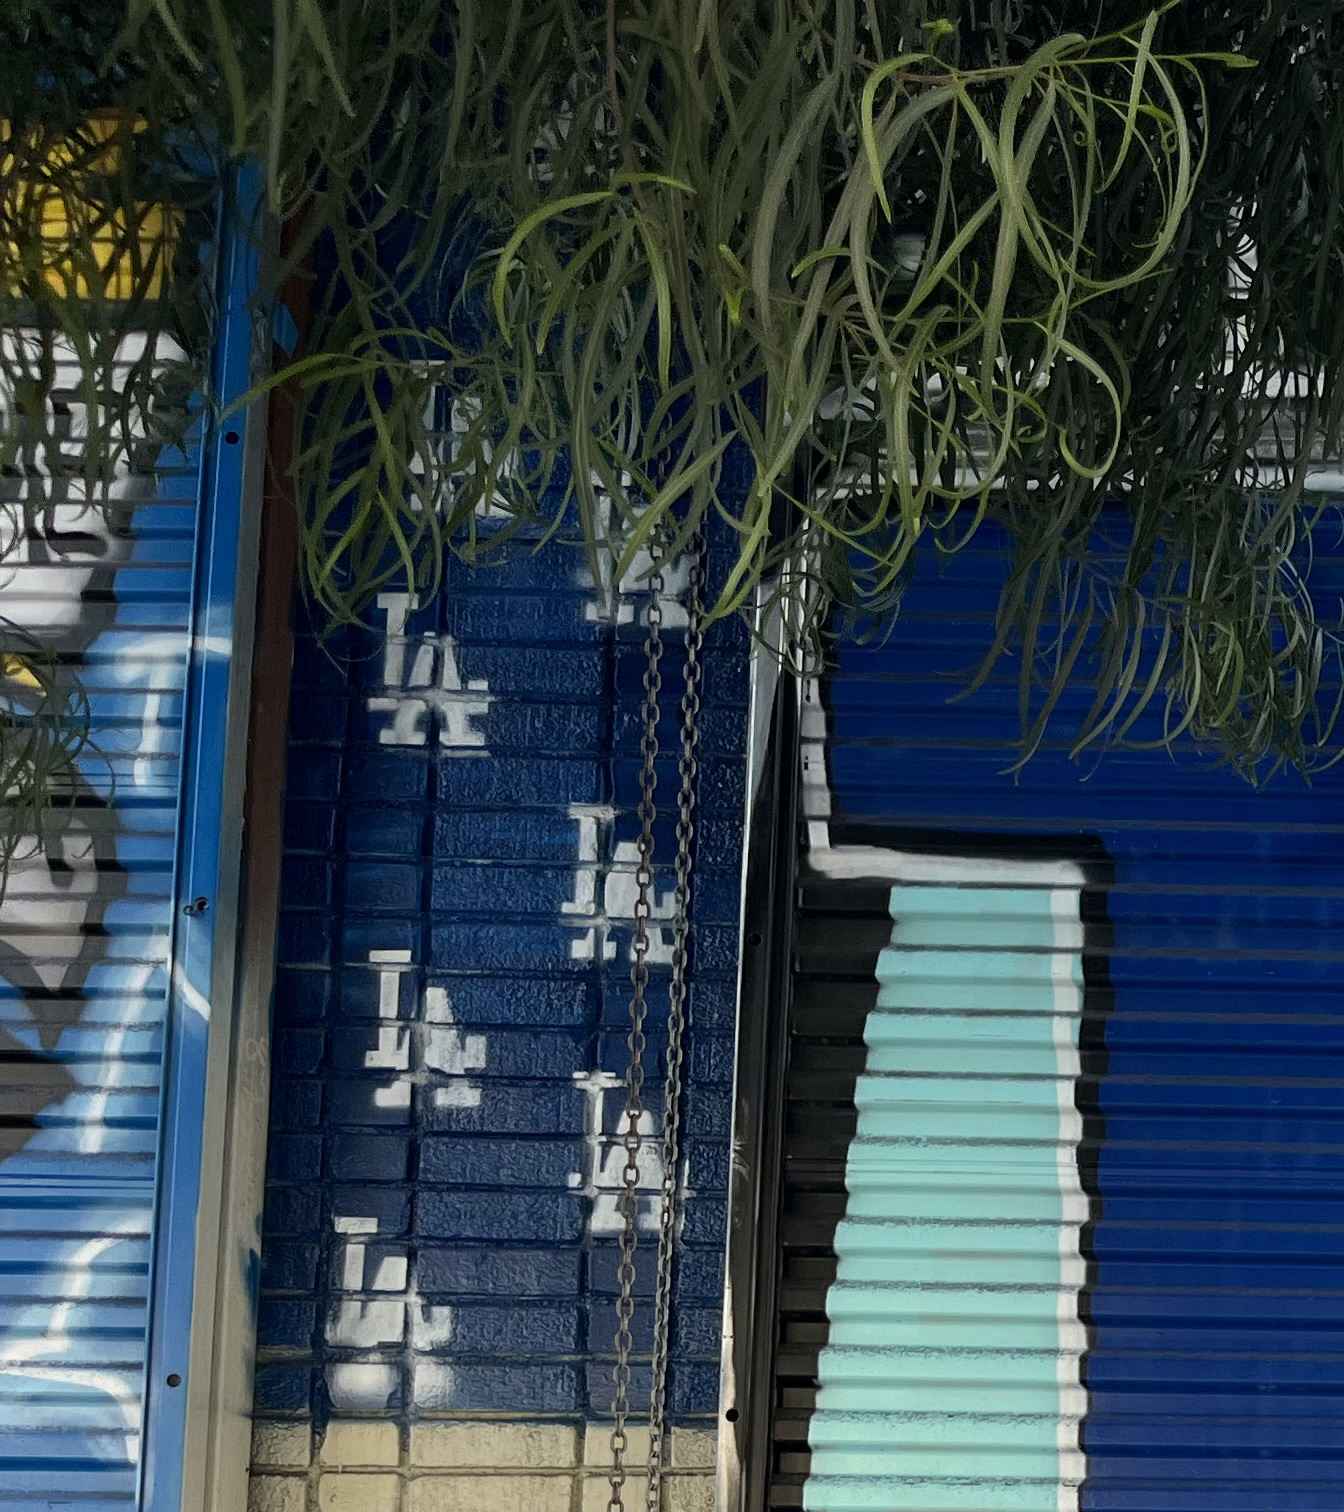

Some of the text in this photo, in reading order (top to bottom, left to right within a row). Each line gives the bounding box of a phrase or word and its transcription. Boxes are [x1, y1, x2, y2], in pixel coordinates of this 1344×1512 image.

[366, 592, 495, 757] LA
[559, 802, 688, 965] LA
[364, 950, 487, 1108] LA
